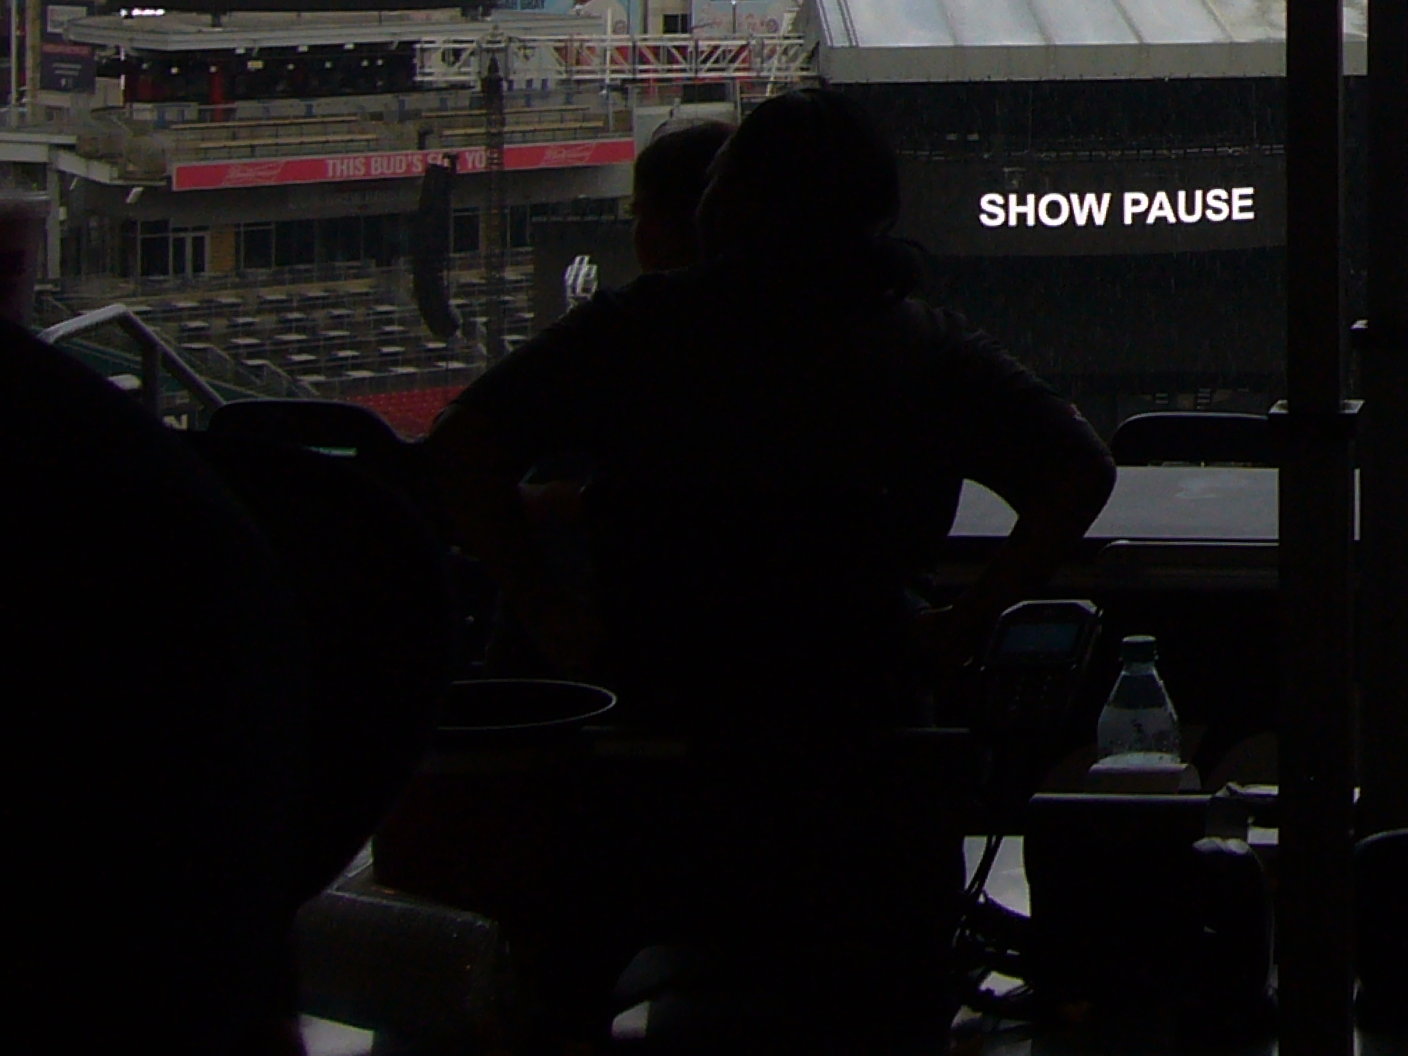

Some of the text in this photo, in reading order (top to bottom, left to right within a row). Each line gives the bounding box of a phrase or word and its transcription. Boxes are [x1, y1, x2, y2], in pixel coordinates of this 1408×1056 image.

[325, 155, 366, 178] THIS
[370, 152, 423, 175] BUD'S
[980, 187, 1254, 227] SHOW PAUSE
